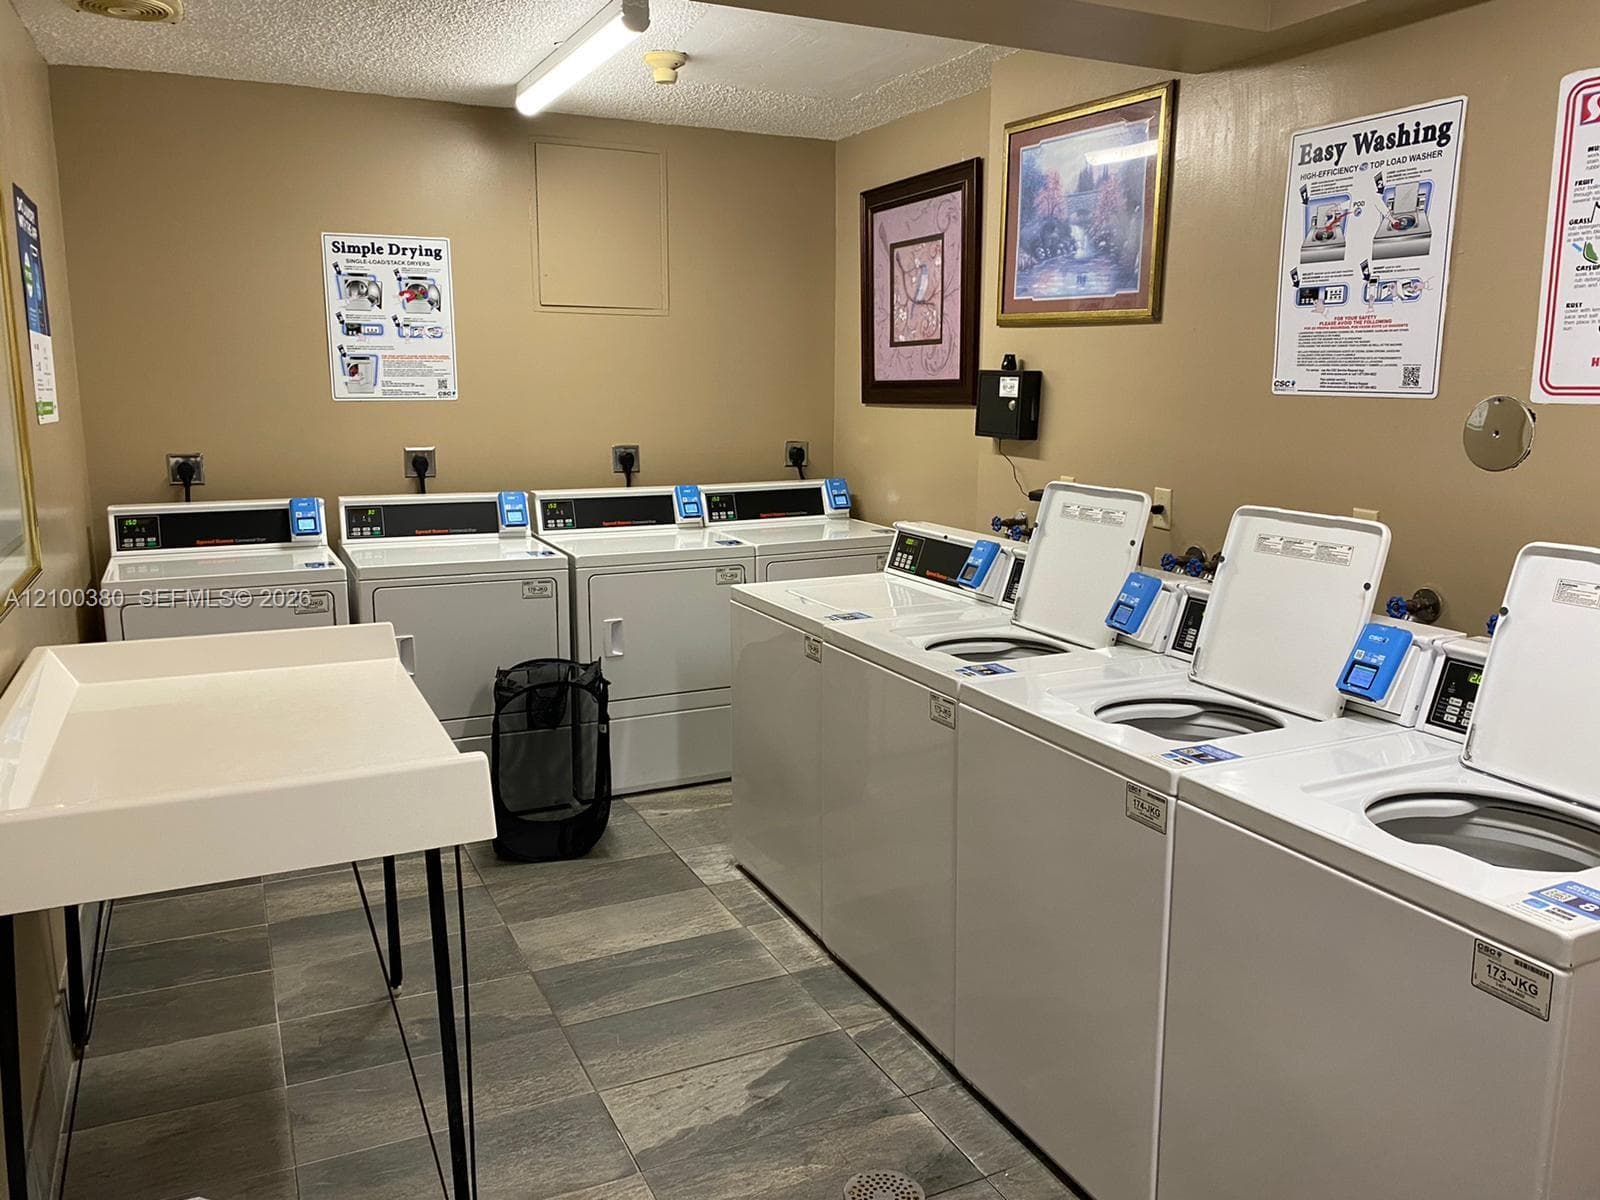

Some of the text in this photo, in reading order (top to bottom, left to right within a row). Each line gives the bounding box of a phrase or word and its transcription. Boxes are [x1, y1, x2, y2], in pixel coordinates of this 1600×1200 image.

[1298, 121, 1453, 167] Easy Washing
[1300, 150, 1443, 181] HIGH-EFFICIENCY TOP LOAD WASHER
[332, 241, 442, 261] Simple Drying
[1477, 942, 1496, 956] CSC
[1486, 963, 1539, 996] 173-JKG
